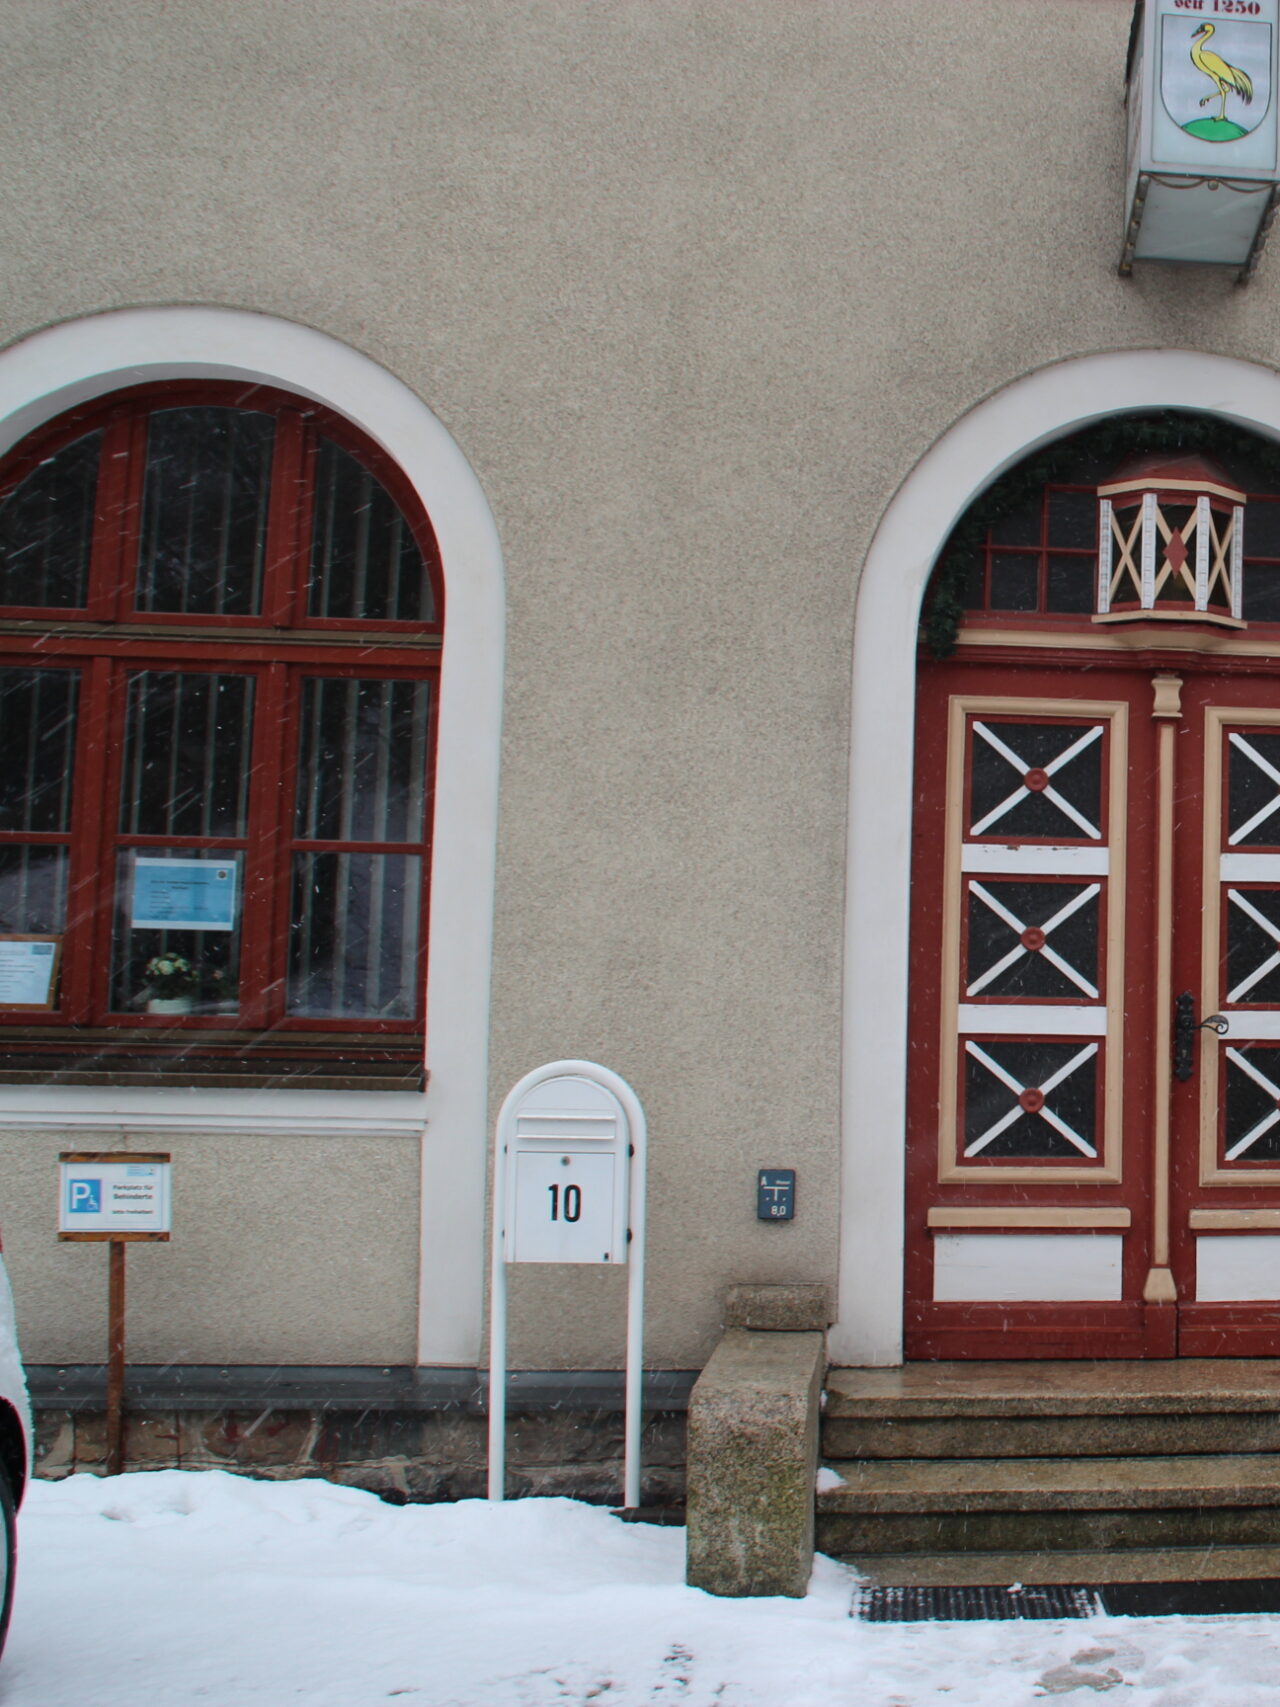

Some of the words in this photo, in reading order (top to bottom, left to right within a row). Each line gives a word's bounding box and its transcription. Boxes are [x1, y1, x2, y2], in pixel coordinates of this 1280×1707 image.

[1213, 0, 1261, 15] 1250
[71, 1182, 91, 1209] P
[548, 1183, 582, 1223] 10
